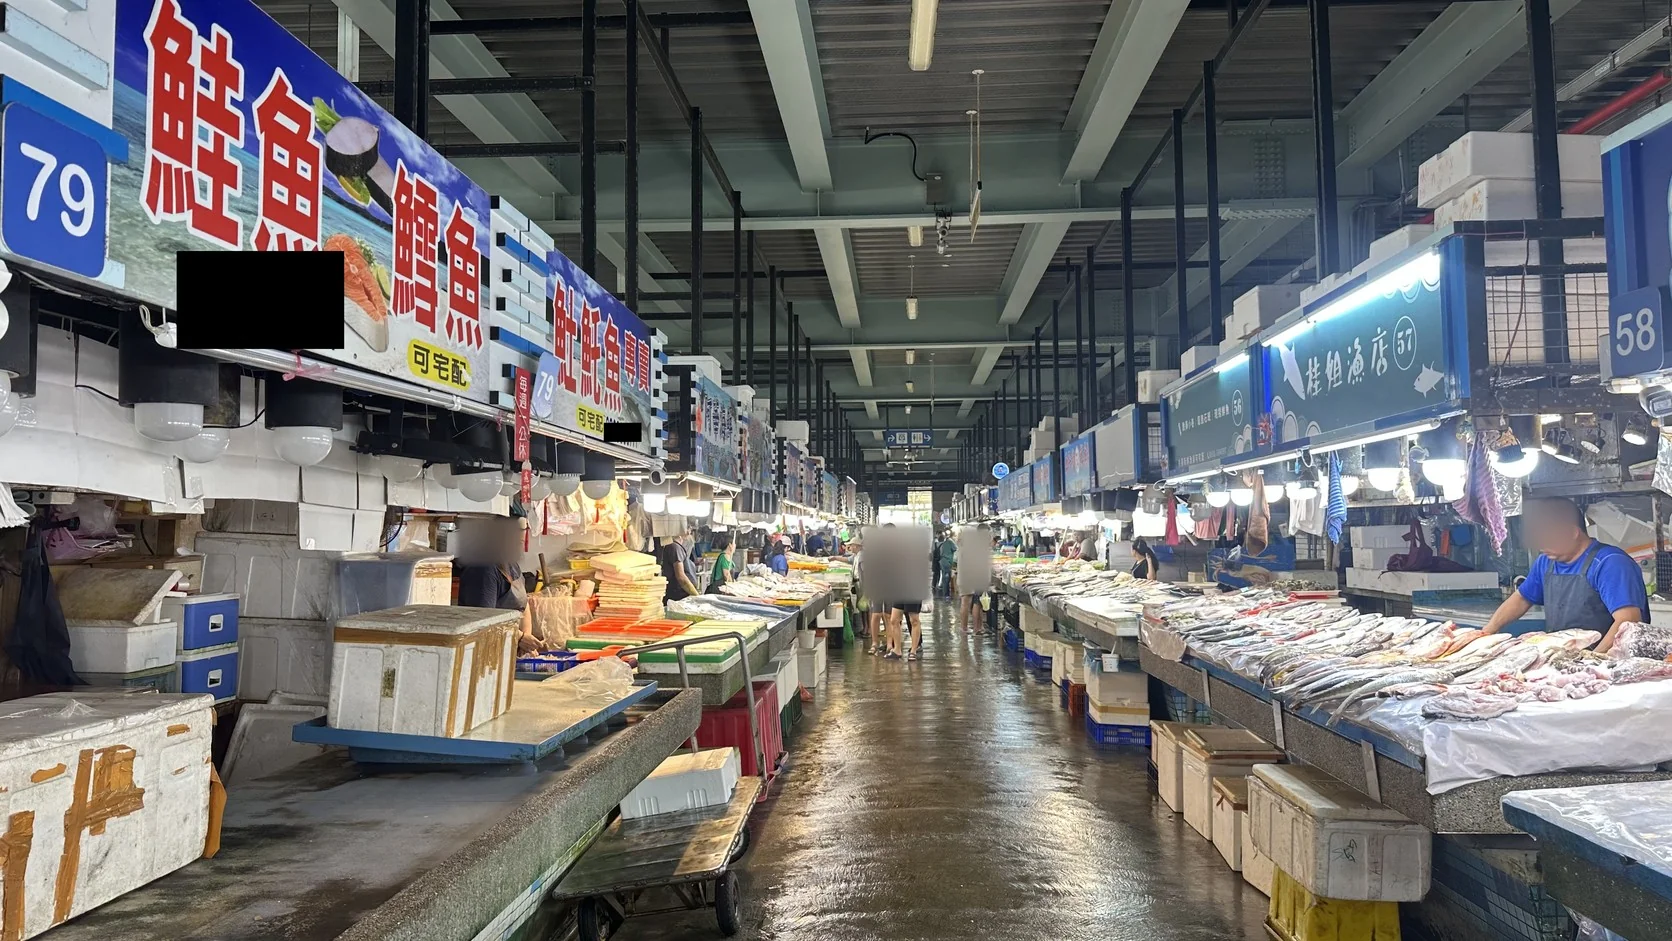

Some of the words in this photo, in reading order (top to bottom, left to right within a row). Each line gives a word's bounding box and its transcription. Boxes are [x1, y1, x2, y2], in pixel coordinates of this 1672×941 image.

[19, 142, 95, 238] 79
[391, 158, 484, 353] 鱈魚
[1397, 328, 1413, 355] 57
[1615, 307, 1656, 357] 58
[412, 344, 467, 388] 可宅配
[537, 371, 554, 401] 79
[578, 407, 604, 433] 可宅配
[1233, 398, 1242, 416] 56
